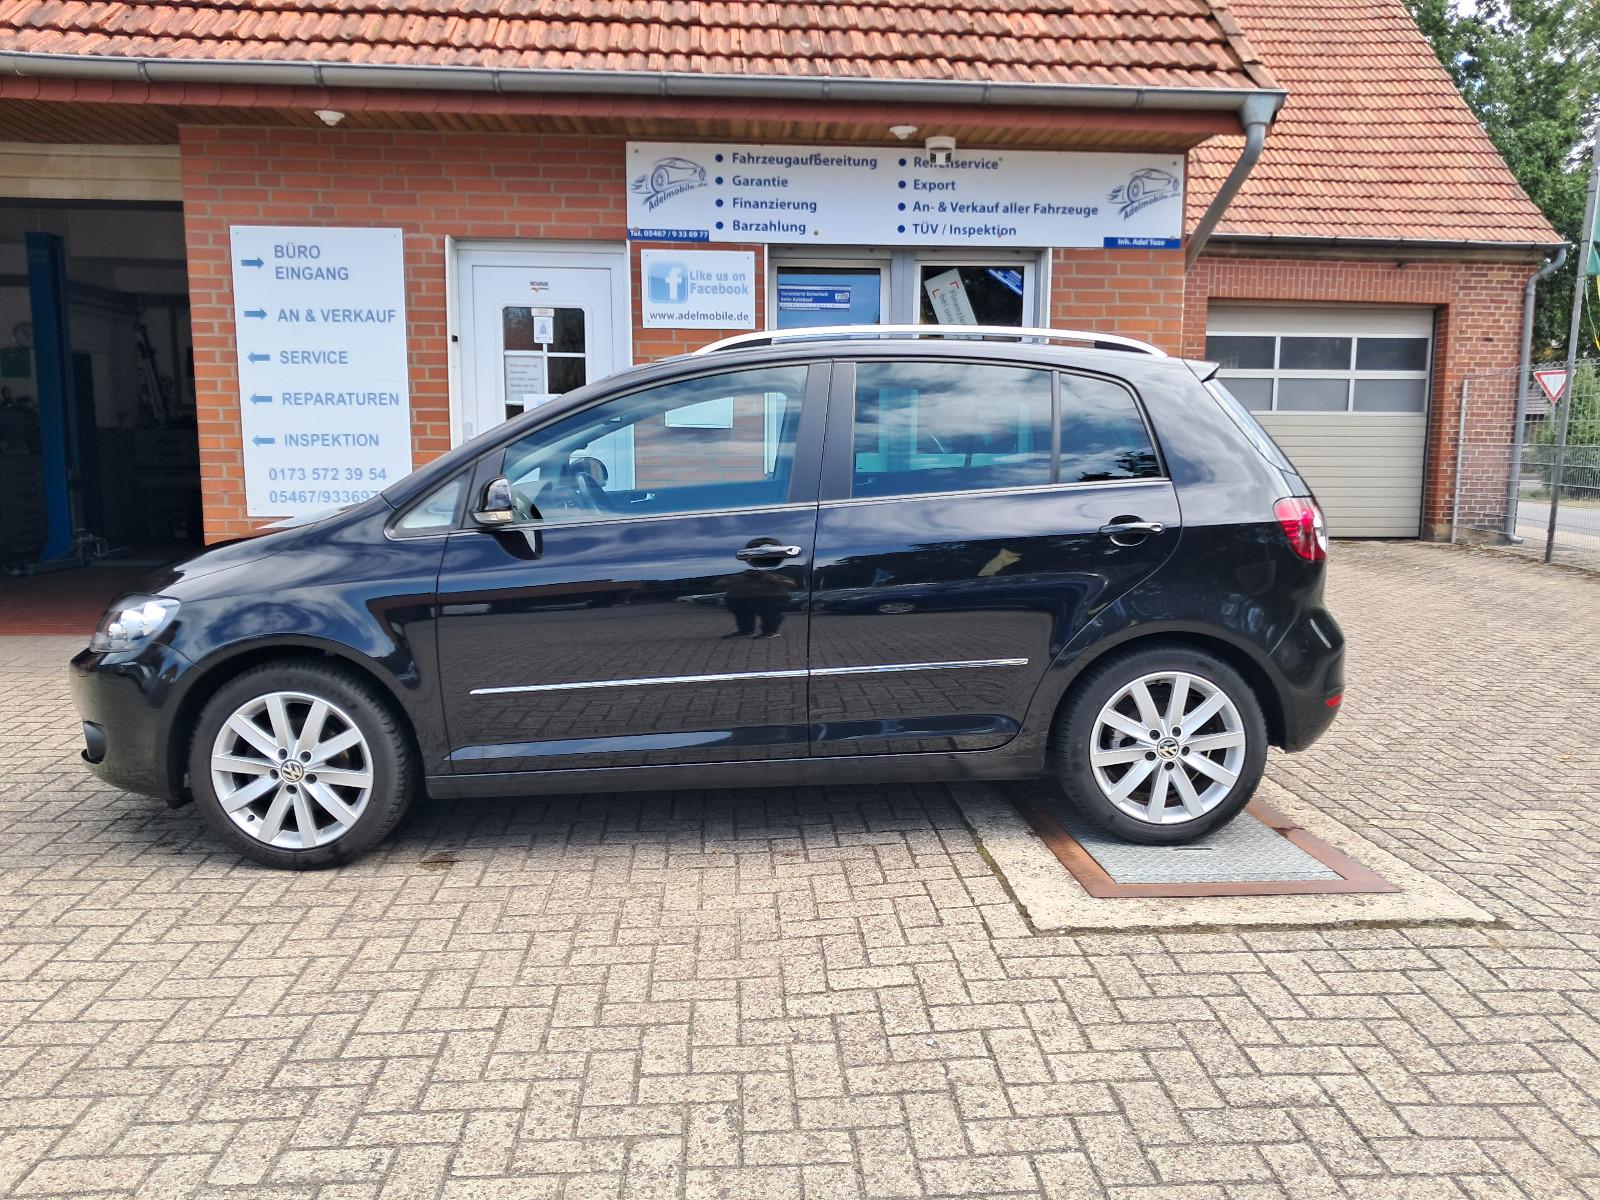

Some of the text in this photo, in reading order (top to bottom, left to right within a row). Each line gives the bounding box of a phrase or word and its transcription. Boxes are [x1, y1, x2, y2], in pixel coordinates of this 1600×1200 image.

[732, 152, 878, 170] Fahrzeugaufbereitung
[913, 157, 999, 170] Renservice
[732, 175, 788, 188] Garantie
[913, 179, 956, 193] Export
[732, 197, 817, 214] Finanzierung
[912, 201, 1099, 218] An- & Verkauf aller Fahrzeuge
[732, 220, 806, 236] Barzahlung
[912, 221, 1017, 238] TÜV / Inspektion
[274, 242, 321, 259] BÜRO
[275, 266, 350, 281] EINGANG
[689, 270, 746, 281] Like us on
[690, 283, 749, 295] Facebook
[277, 309, 396, 323] AN & VERKAUF
[649, 310, 749, 321] www.adelmobile.de
[279, 350, 349, 365] SERVICE
[282, 392, 400, 406] REPARATUREN
[284, 433, 379, 447] INSPEKTION
[268, 467, 387, 481] 0173 572 39 54
